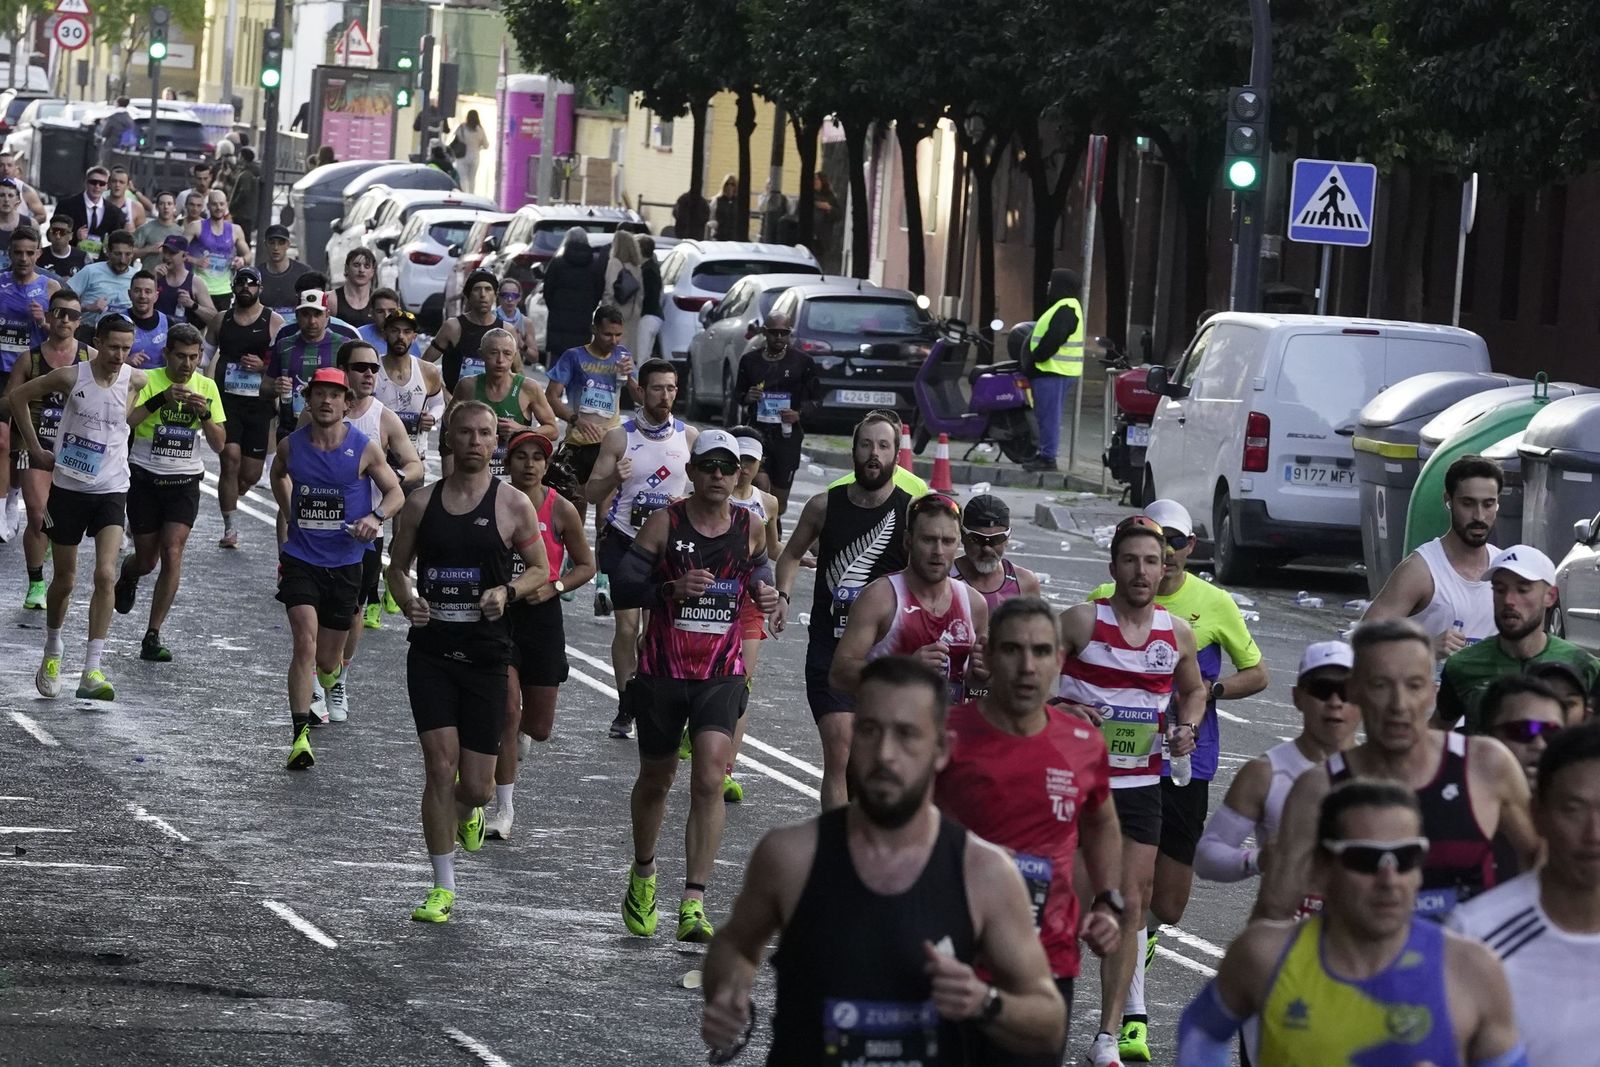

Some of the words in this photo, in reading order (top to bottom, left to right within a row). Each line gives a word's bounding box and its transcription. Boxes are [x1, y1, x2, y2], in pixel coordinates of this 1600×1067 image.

[61, 26, 82, 39] 30
[584, 396, 612, 410] HÉCTOR
[843, 392, 870, 403] 4249
[168, 428, 192, 436] ZURICH
[78, 439, 102, 452] ZURICH
[151, 446, 192, 458] JAVIERDEBE
[62, 455, 95, 474] SERTOLI
[1293, 467, 1326, 481] 9177
[1330, 470, 1355, 483] MFY
[312, 487, 339, 495] ZURICH
[312, 500, 327, 508] 3794
[300, 508, 341, 520] CHARLOT
[440, 571, 473, 579] ZURICH
[441, 586, 459, 595] 4542
[698, 597, 716, 605] 5041
[681, 606, 732, 621] IRONDOC
[969, 688, 988, 697] 5212
[1118, 710, 1153, 720] ZURICH
[1115, 728, 1135, 738] 2795
[1110, 739, 1136, 754] FON
